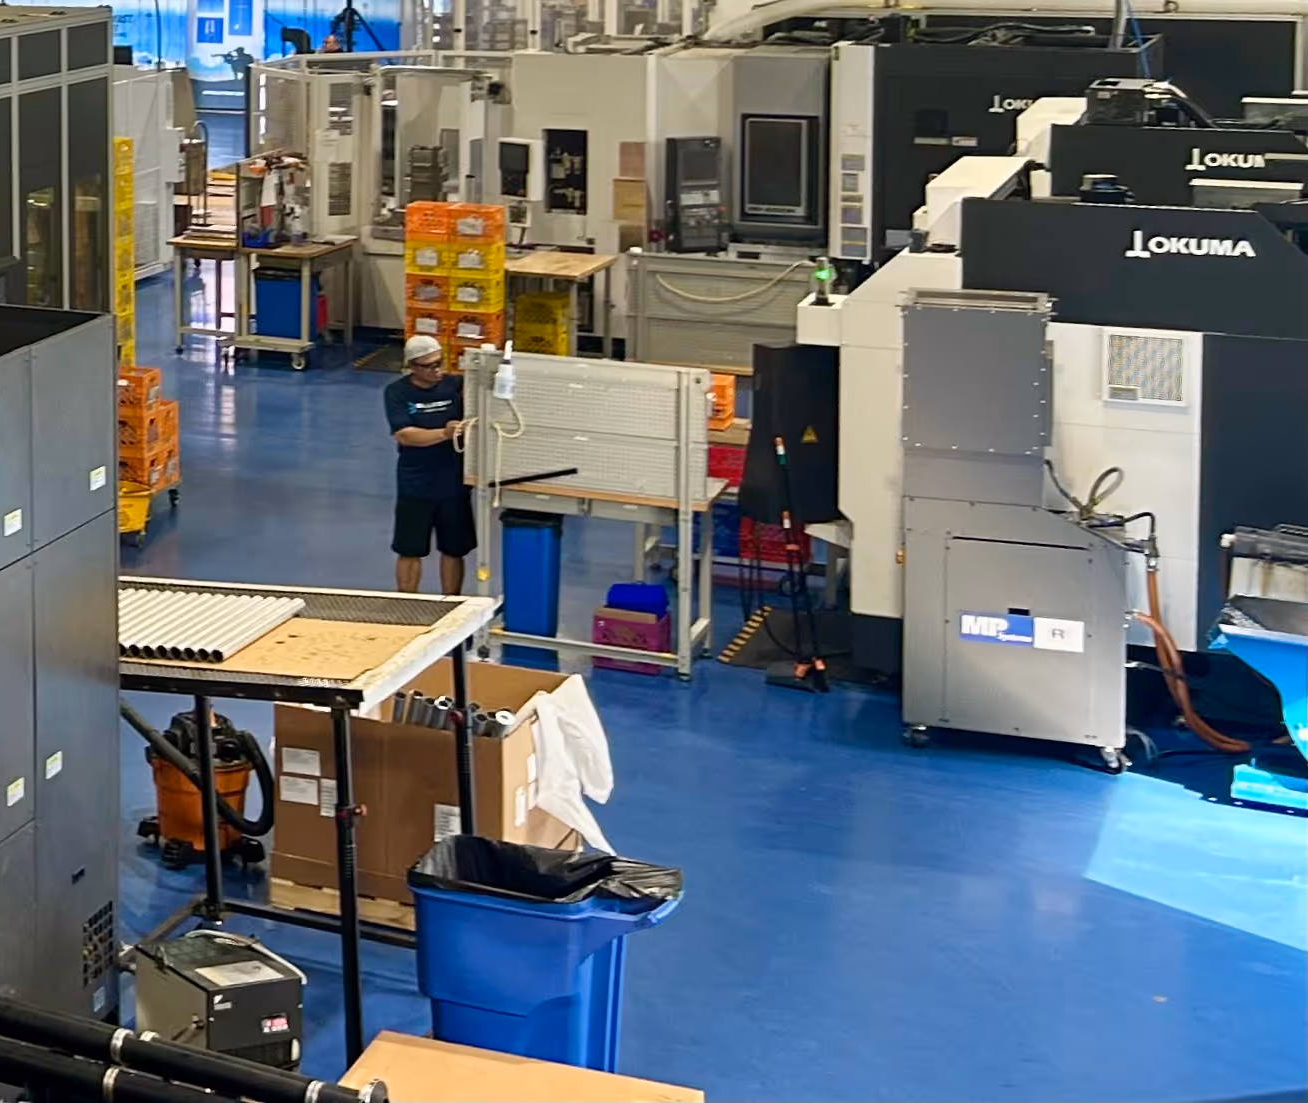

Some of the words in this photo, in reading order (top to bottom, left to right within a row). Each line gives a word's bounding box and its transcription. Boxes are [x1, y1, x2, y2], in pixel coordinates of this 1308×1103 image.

[1204, 152, 1265, 169] OKU
[1147, 236, 1257, 257] OKUMA
[961, 614, 1008, 637] MP
